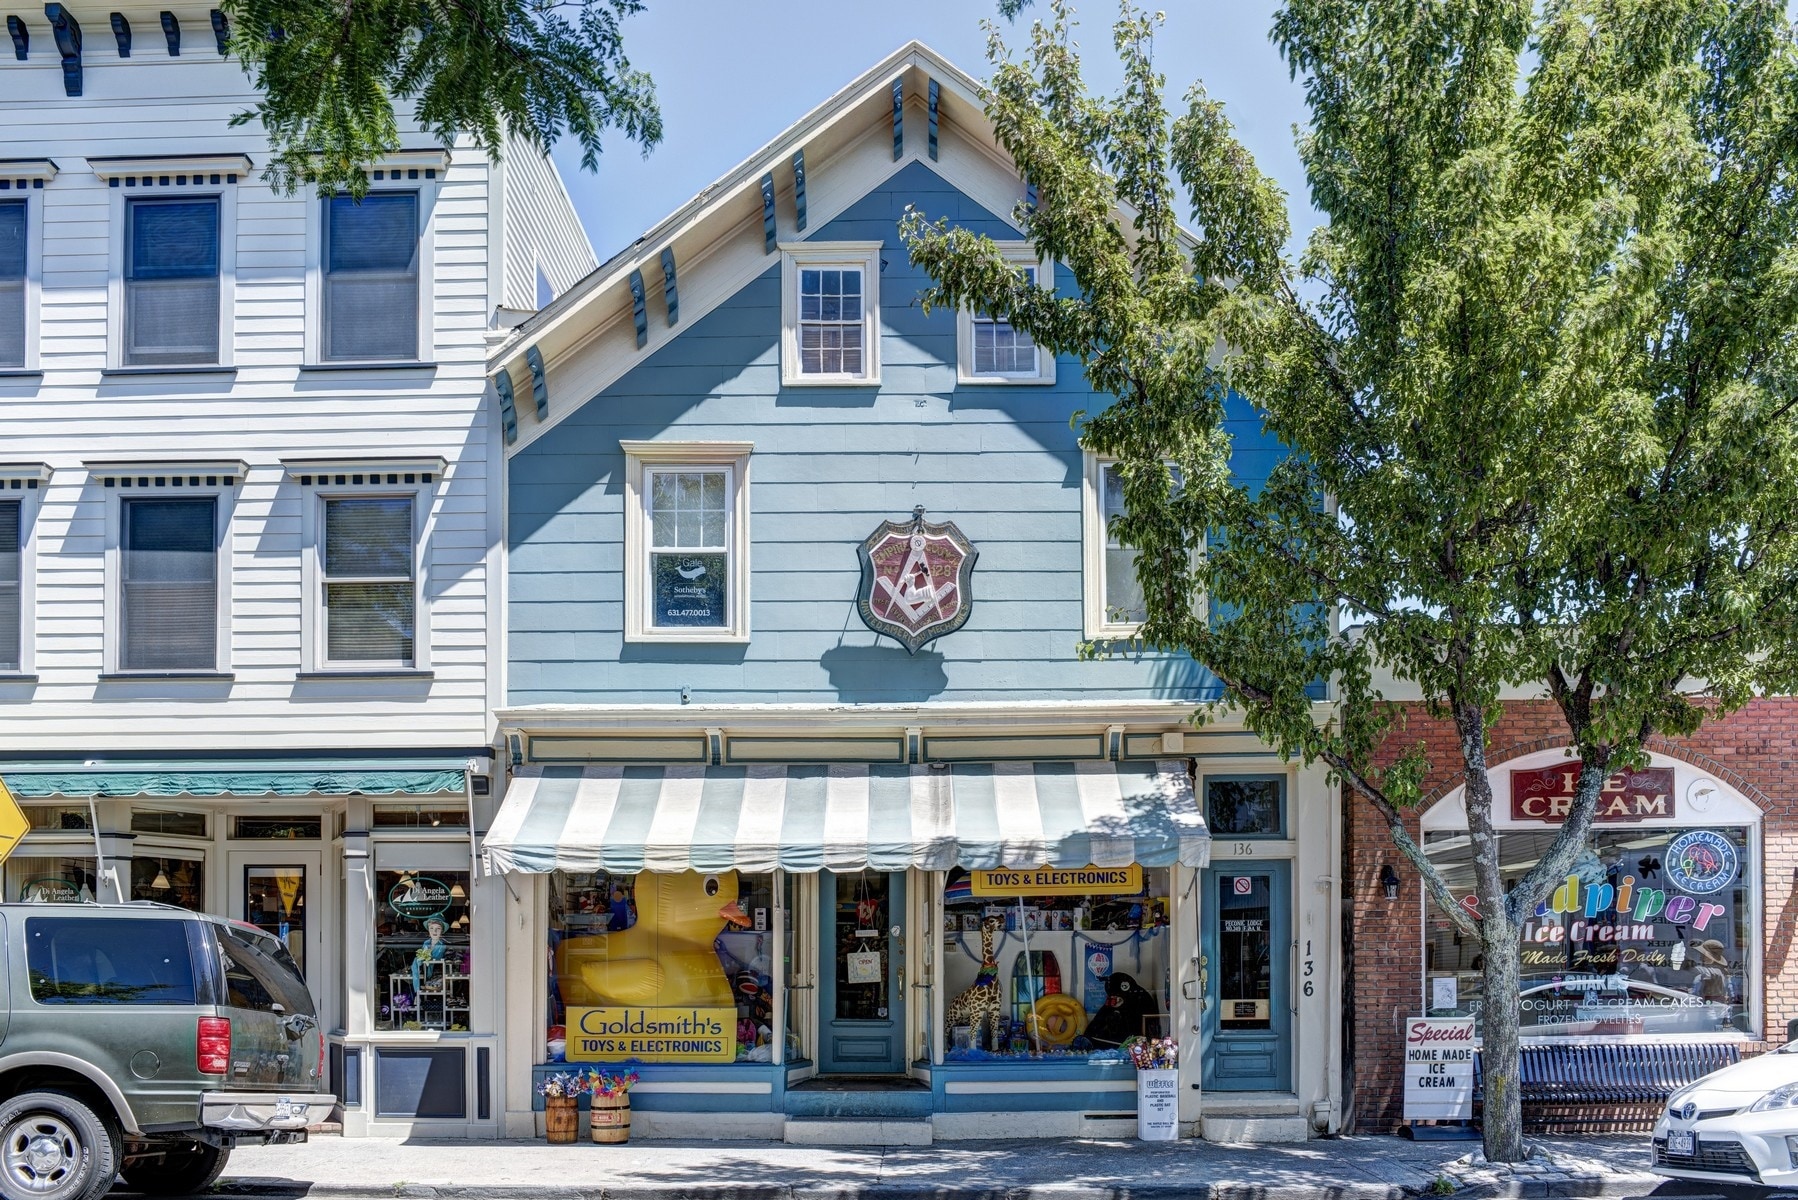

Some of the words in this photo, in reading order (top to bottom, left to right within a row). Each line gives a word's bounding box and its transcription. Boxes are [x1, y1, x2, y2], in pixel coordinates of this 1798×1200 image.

[931, 564, 952, 577] 128
[667, 609, 711, 617] 631.477.0013
[860, 600, 884, 632] UNITED
[884, 625, 926, 647] AMERICAN
[928, 603, 970, 636] MECHANICS
[1560, 772, 1628, 793] IE
[1520, 794, 1668, 817] CRAM
[1233, 843, 1253, 855] 136
[1671, 831, 1732, 857] HOMEMADE
[986, 873, 1020, 886] TOYS
[1023, 874, 1032, 885] &
[1035, 871, 1128, 885] ELECTRONICS
[1689, 871, 1731, 891] CREAM
[52, 887, 74, 896] Angela
[421, 887, 446, 895] Angela
[1522, 921, 1565, 943] Ice
[1570, 920, 1655, 942] Cream
[1520, 950, 1568, 965] Made
[1572, 949, 1617, 966] Fresh
[1620, 948, 1666, 966] Daily
[1303, 939, 1314, 997] 136
[1564, 974, 1630, 991] SHAKES
[1519, 999, 1571, 1011] OGURT
[1582, 999, 1604, 1009] ICE
[1607, 998, 1656, 1009] CREAM
[1659, 996, 1704, 1008] CAKES
[579, 1009, 722, 1035] Goldsmith's
[1537, 1015, 1579, 1025] FROZEN
[1584, 1014, 1641, 1025] NOVELTIES
[1407, 1022, 1474, 1047] Special
[581, 1039, 615, 1052] TOYS
[618, 1040, 627, 1052] &
[631, 1040, 722, 1053] ELECTRONICS
[1408, 1049, 1438, 1061] HOME
[1442, 1048, 1472, 1060] MADE
[1428, 1063, 1446, 1074] ICE
[1418, 1076, 1455, 1088] CREAM
